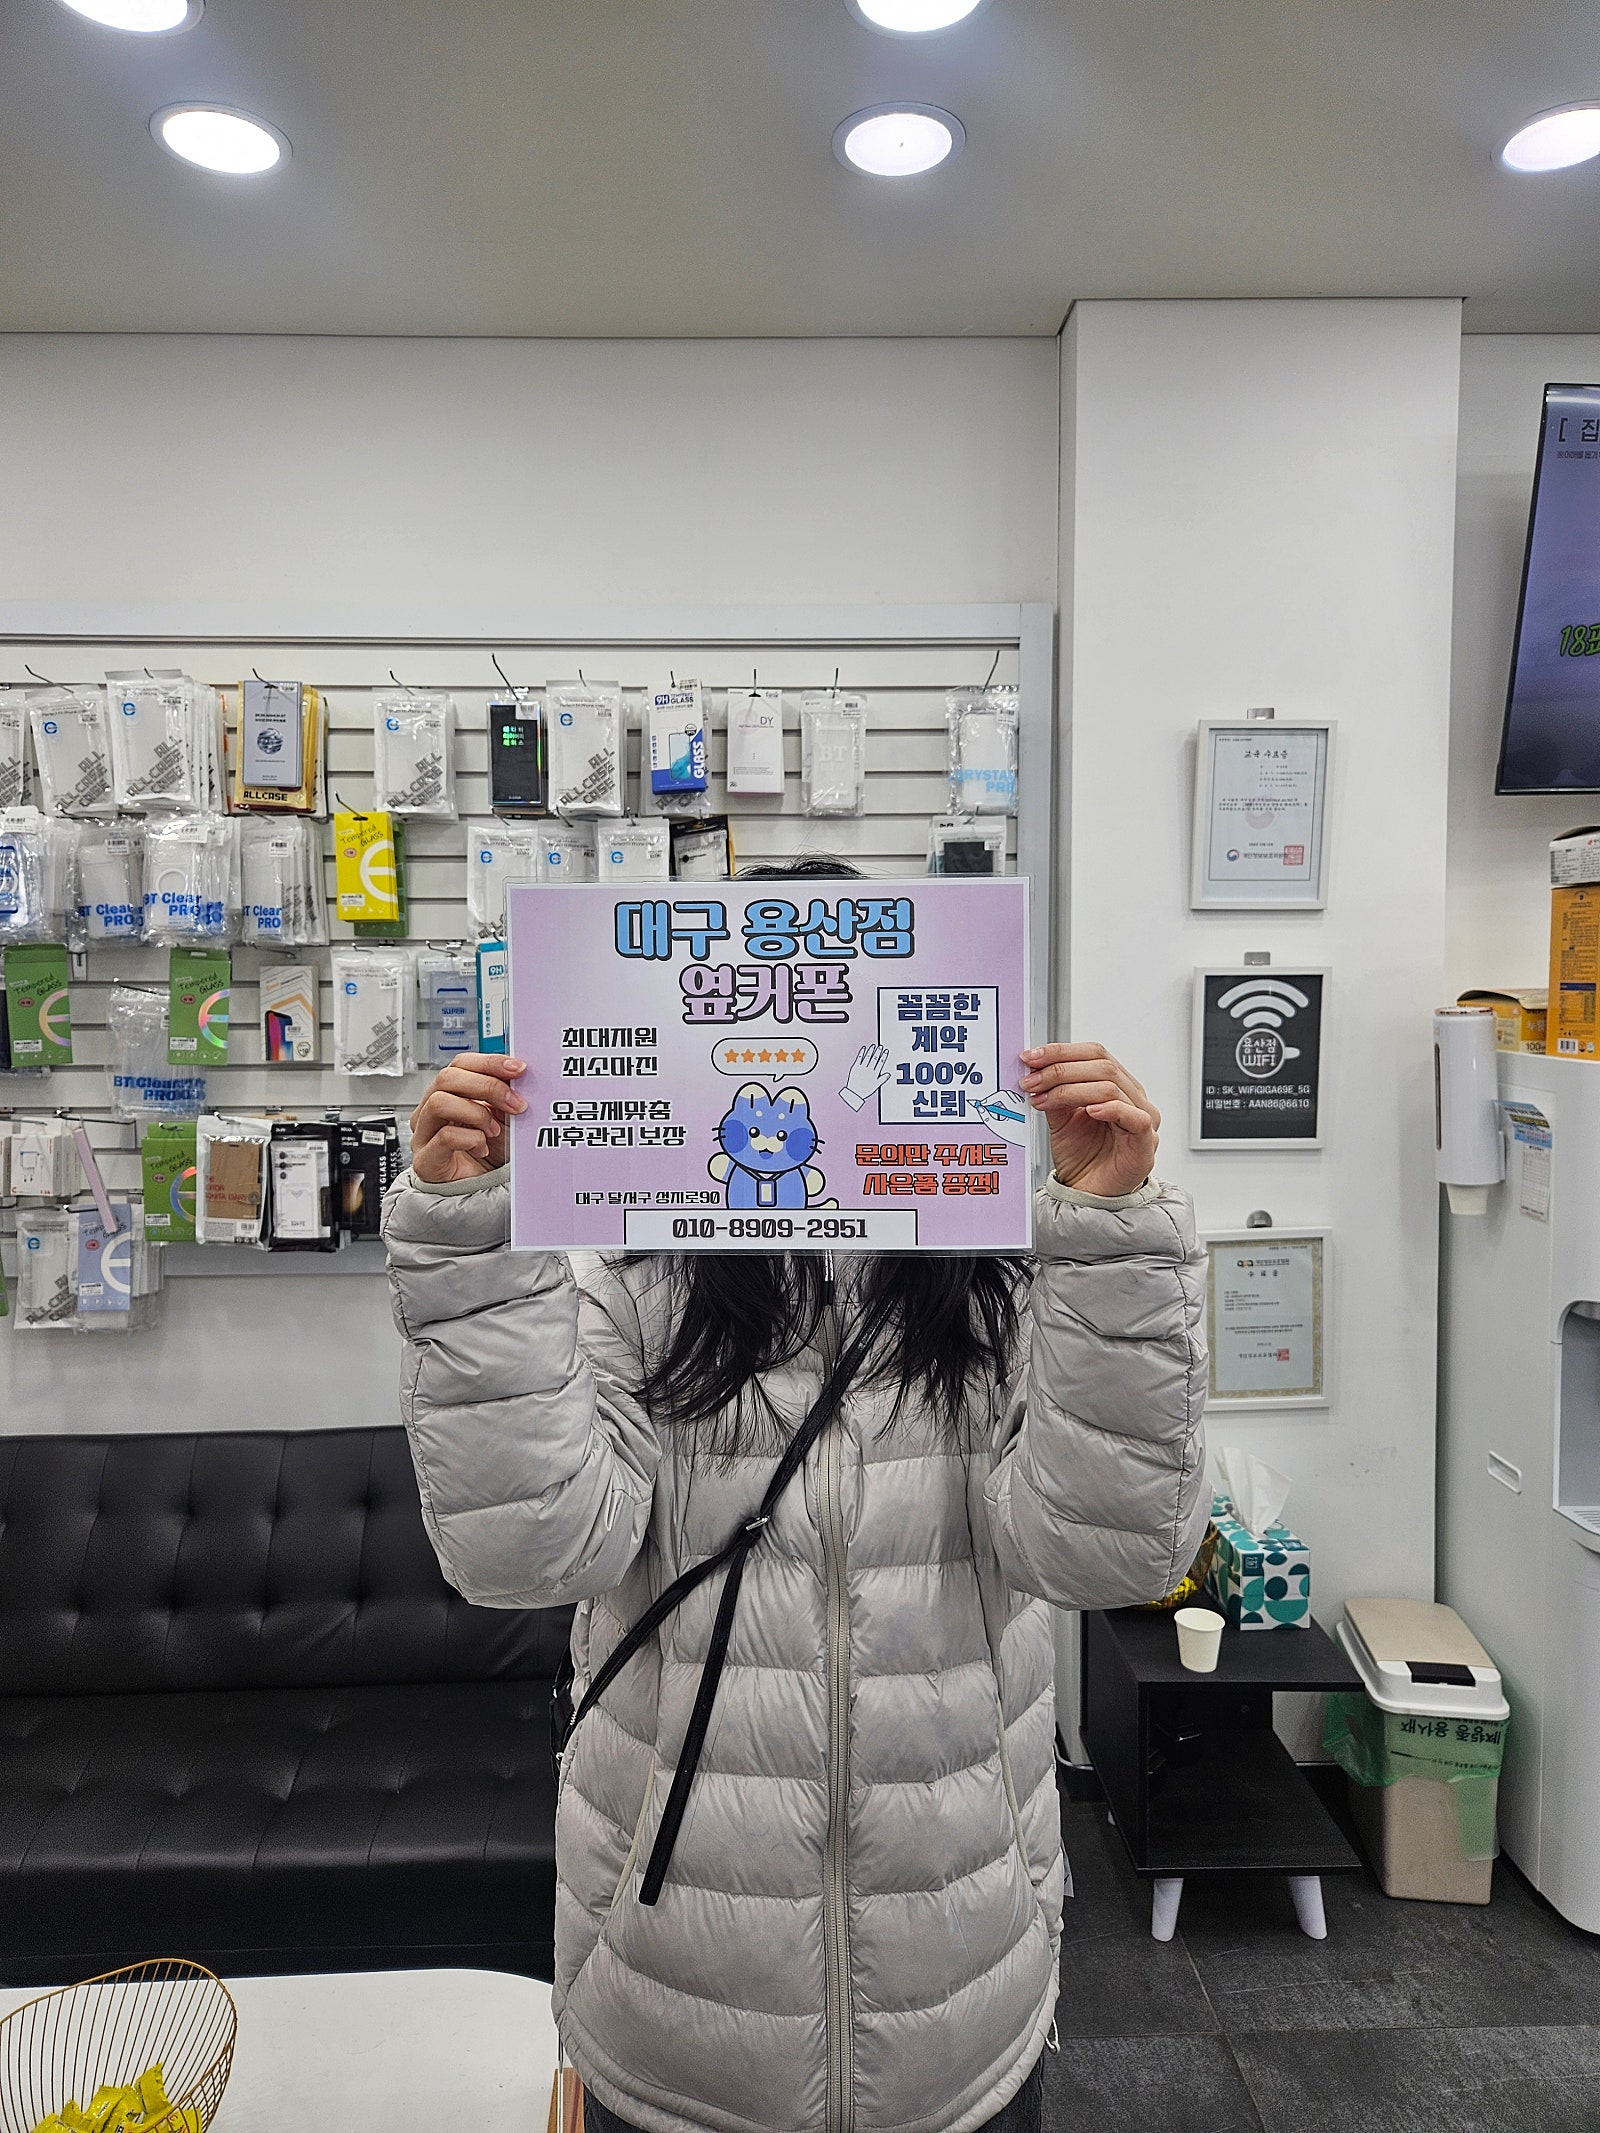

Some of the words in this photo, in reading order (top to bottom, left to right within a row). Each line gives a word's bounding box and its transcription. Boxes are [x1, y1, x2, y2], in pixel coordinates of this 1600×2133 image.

[1581, 419, 1600, 442] 집
[655, 695, 669, 704] 9H
[760, 717, 773, 725] DY
[693, 741, 706, 779] GLASS
[360, 830, 384, 848] GLASS
[253, 905, 281, 916] Clear
[258, 917, 281, 928] PRO
[614, 900, 729, 961] 대구
[741, 898, 915, 960] 용산점
[489, 966, 503, 975] 9H
[679, 963, 854, 1024] 옆커폰
[897, 993, 981, 1021] 꼼꼼한
[442, 1017, 463, 1029] BT
[561, 1027, 658, 1048] 최대지원
[911, 1026, 968, 1053] 계약
[1242, 1037, 1277, 1054] 용산점
[561, 1056, 658, 1077] 최소마진
[1242, 1054, 1276, 1066] WIFI
[896, 1062, 983, 1085] 100%
[551, 1100, 671, 1121] 요금제맞춤
[912, 1090, 966, 1117] 신뢰
[1205, 1099, 1241, 1109] 비밀번호
[537, 1127, 634, 1147] 사후관리
[639, 1126, 687, 1146] 보장
[855, 1143, 931, 1166] 문의만
[934, 1143, 1009, 1166] 주셔도
[863, 1172, 938, 1195] 사은품
[942, 1171, 999, 1195] 증정!
[575, 1192, 604, 1204] 대구
[608, 1191, 652, 1204] 달서구
[656, 1191, 721, 1204] 성지로90
[672, 1218, 868, 1238] 010-8909-2951
